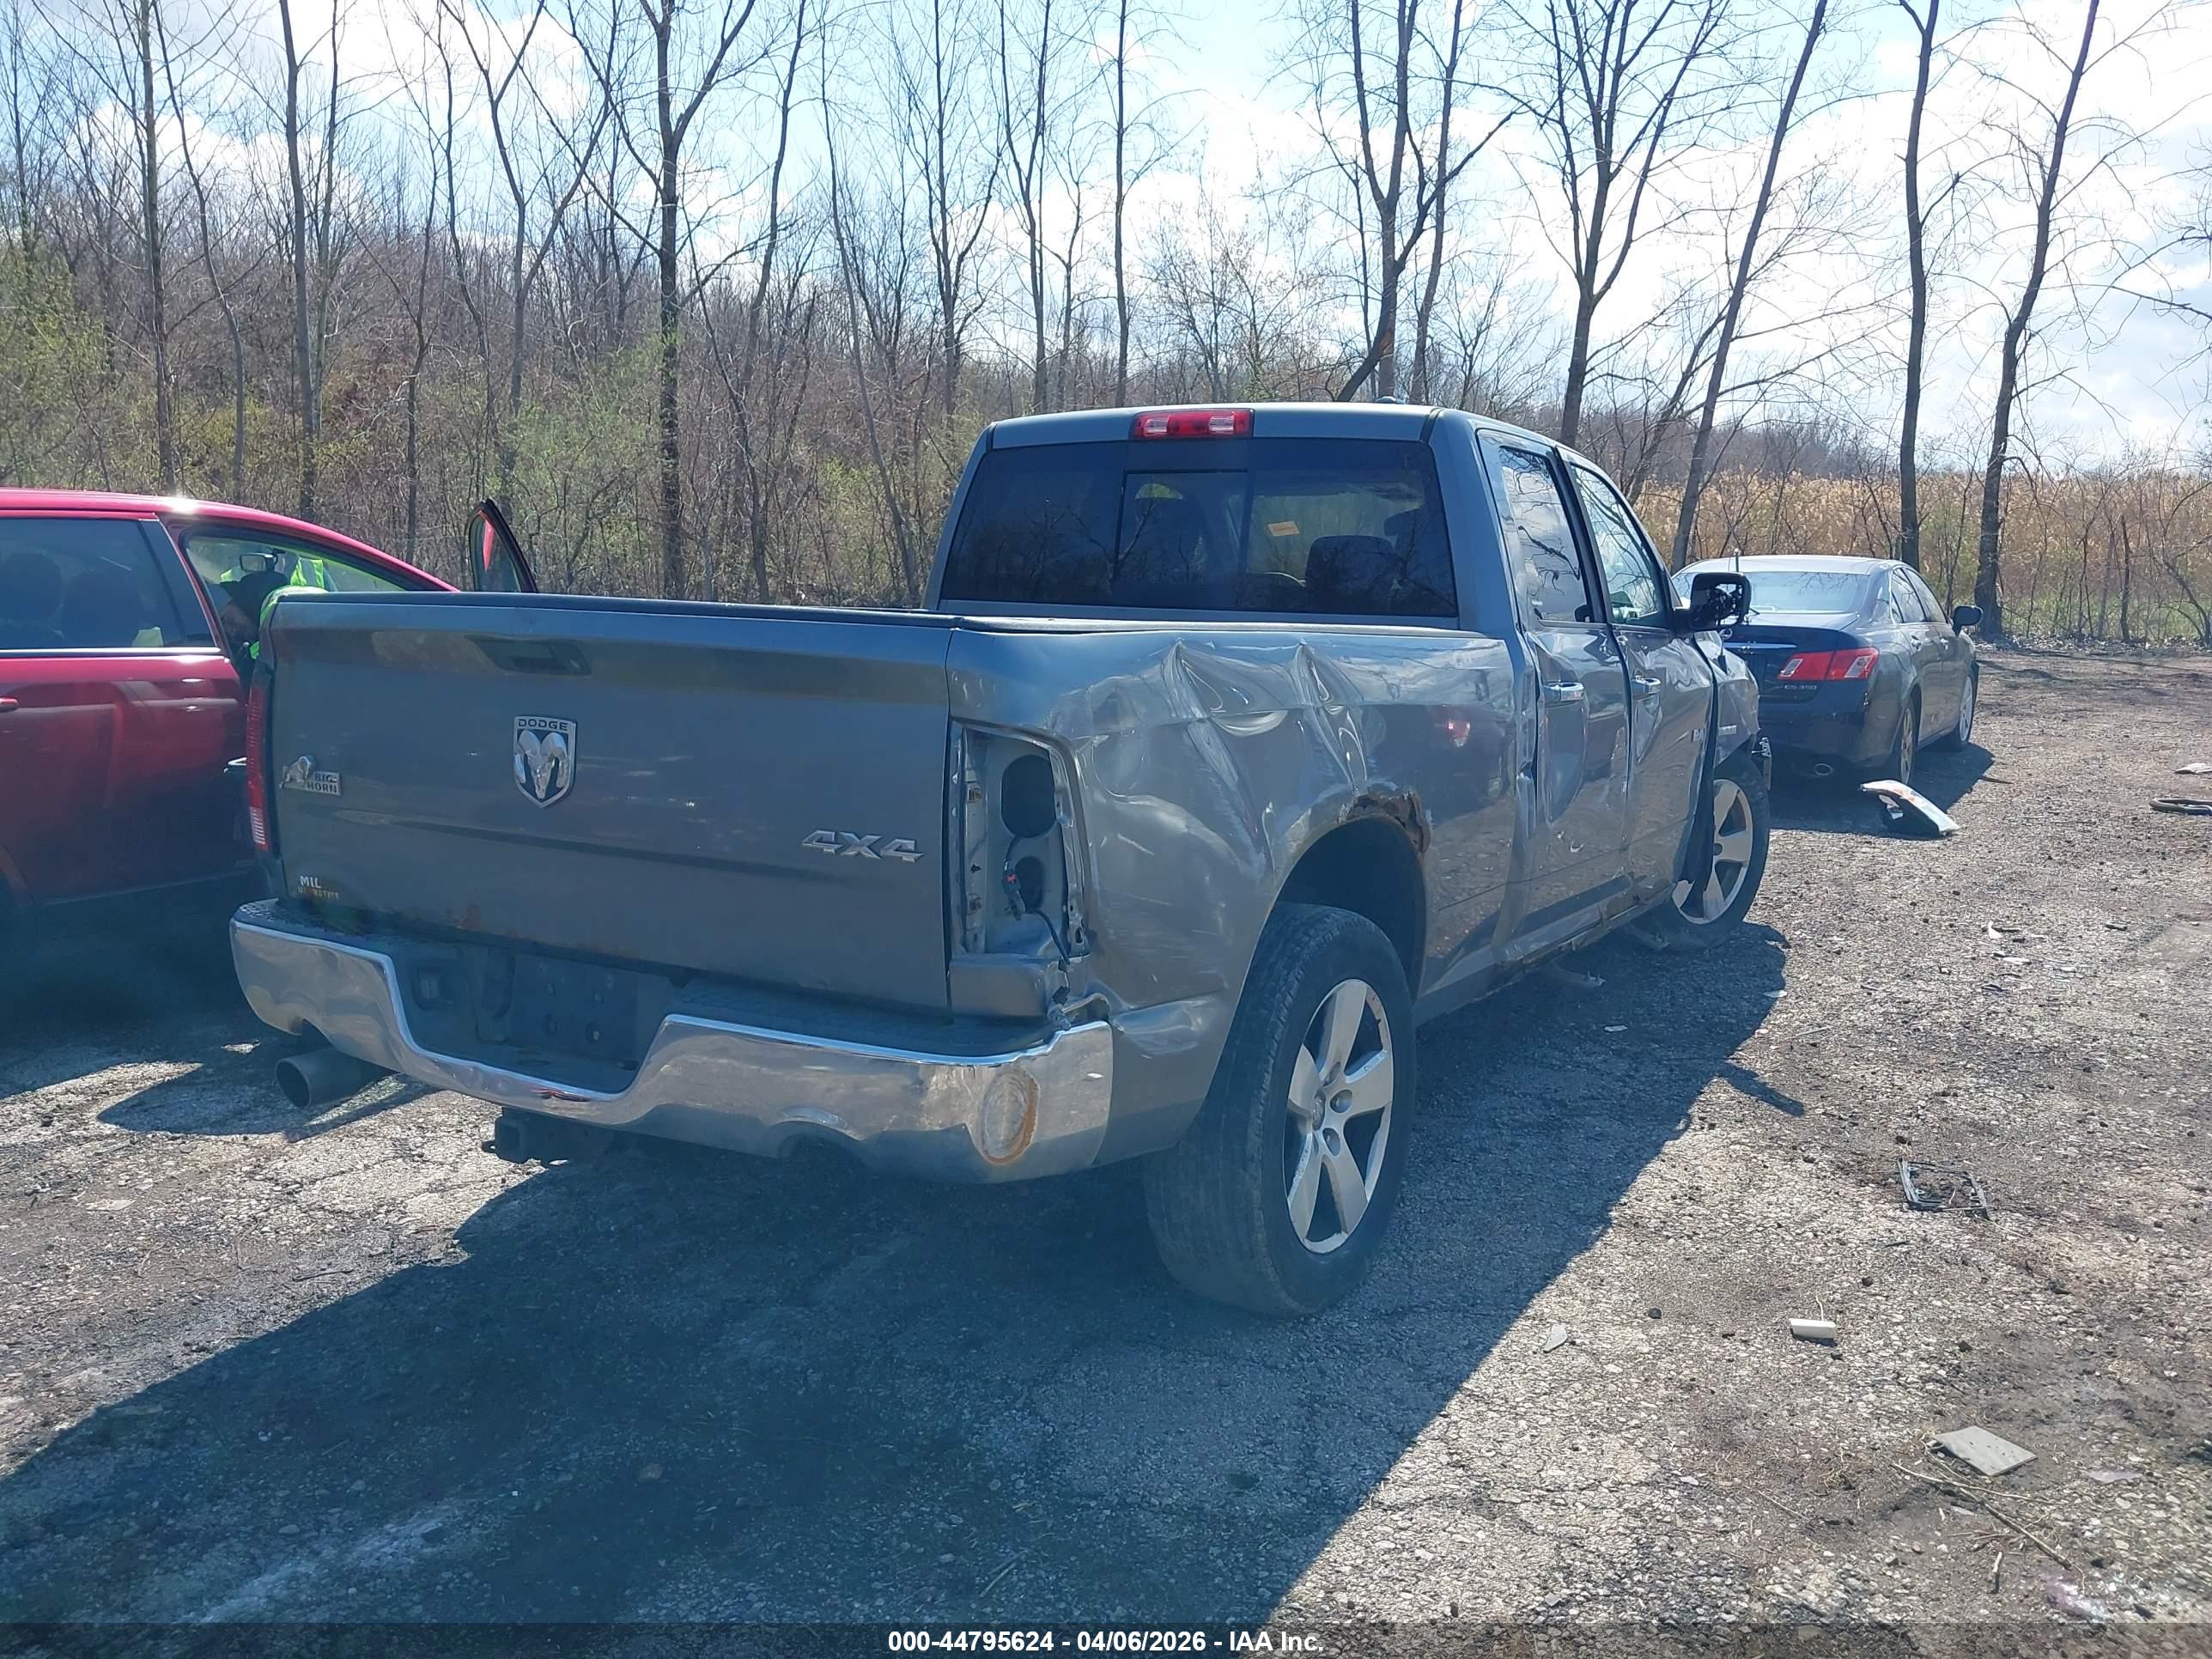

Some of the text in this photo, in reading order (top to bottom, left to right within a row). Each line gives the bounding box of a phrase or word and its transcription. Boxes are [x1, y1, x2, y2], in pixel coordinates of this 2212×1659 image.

[518, 719, 568, 731] DODGE
[315, 773, 337, 783] BIG
[307, 781, 337, 793] HORN
[300, 875, 321, 889] MIL
